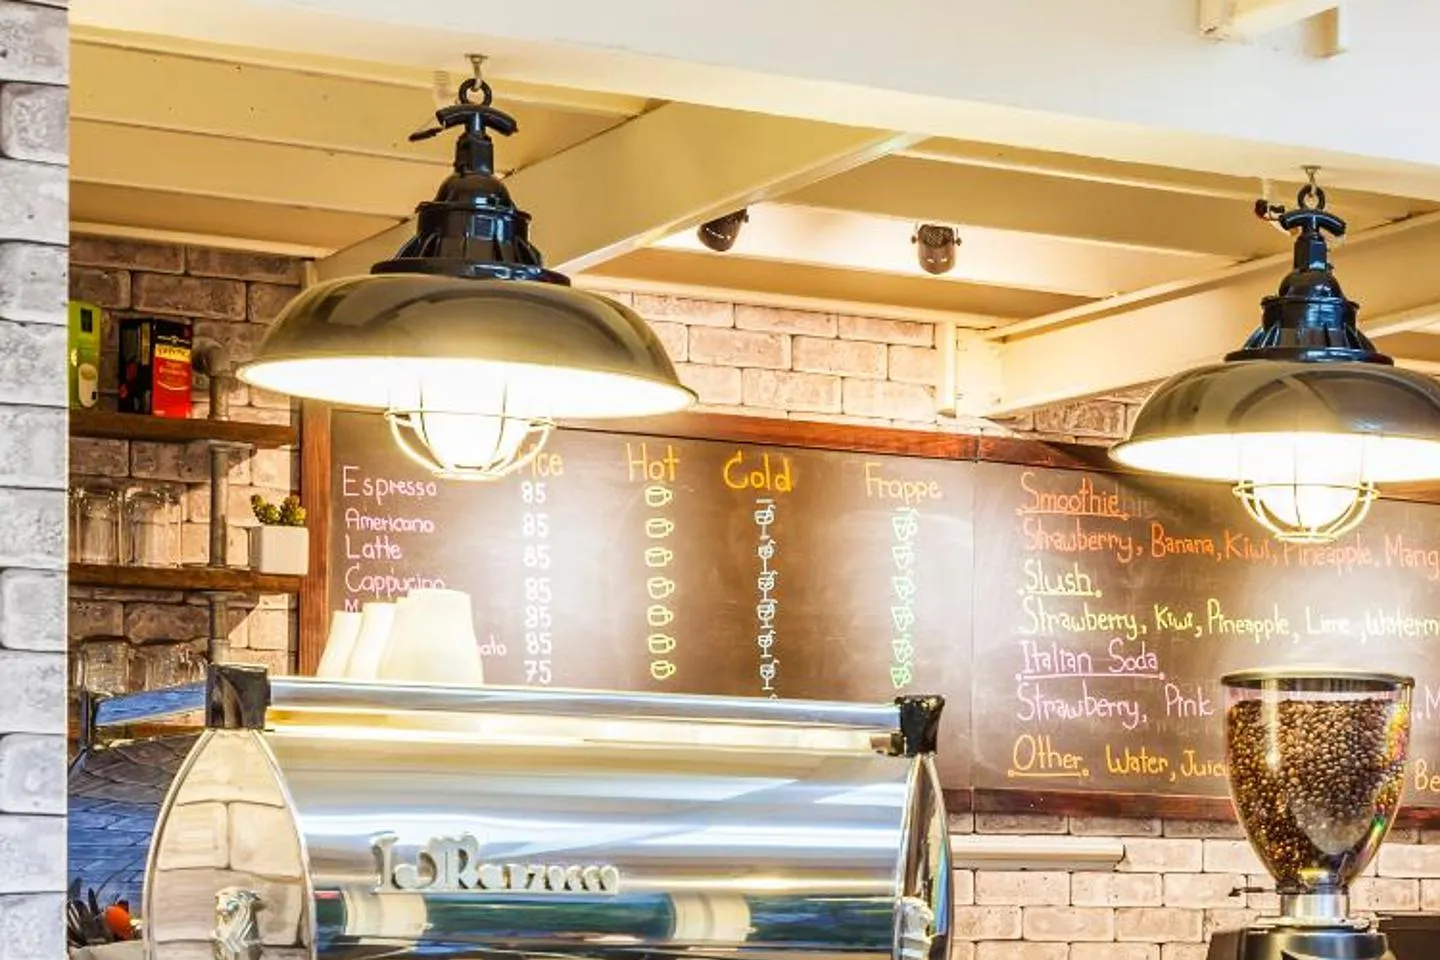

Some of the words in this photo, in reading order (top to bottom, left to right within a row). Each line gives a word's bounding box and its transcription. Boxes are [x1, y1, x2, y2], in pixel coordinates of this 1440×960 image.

[342, 465, 437, 505] Espresso
[521, 480, 547, 504] 85
[624, 442, 680, 482] Hot
[723, 450, 793, 492] Cold
[864, 462, 943, 505] Frappe
[1020, 472, 1120, 513] Smoothie
[345, 508, 435, 534] Americano
[522, 512, 549, 538] 85
[345, 534, 402, 560] Latte
[523, 546, 550, 570] 85
[525, 577, 552, 603] 85
[524, 606, 552, 629] 85
[525, 633, 552, 656] 85
[1020, 639, 1092, 673] Italian
[1108, 638, 1158, 673] Soda
[523, 660, 552, 684] 75
[1165, 683, 1214, 718] Pink
